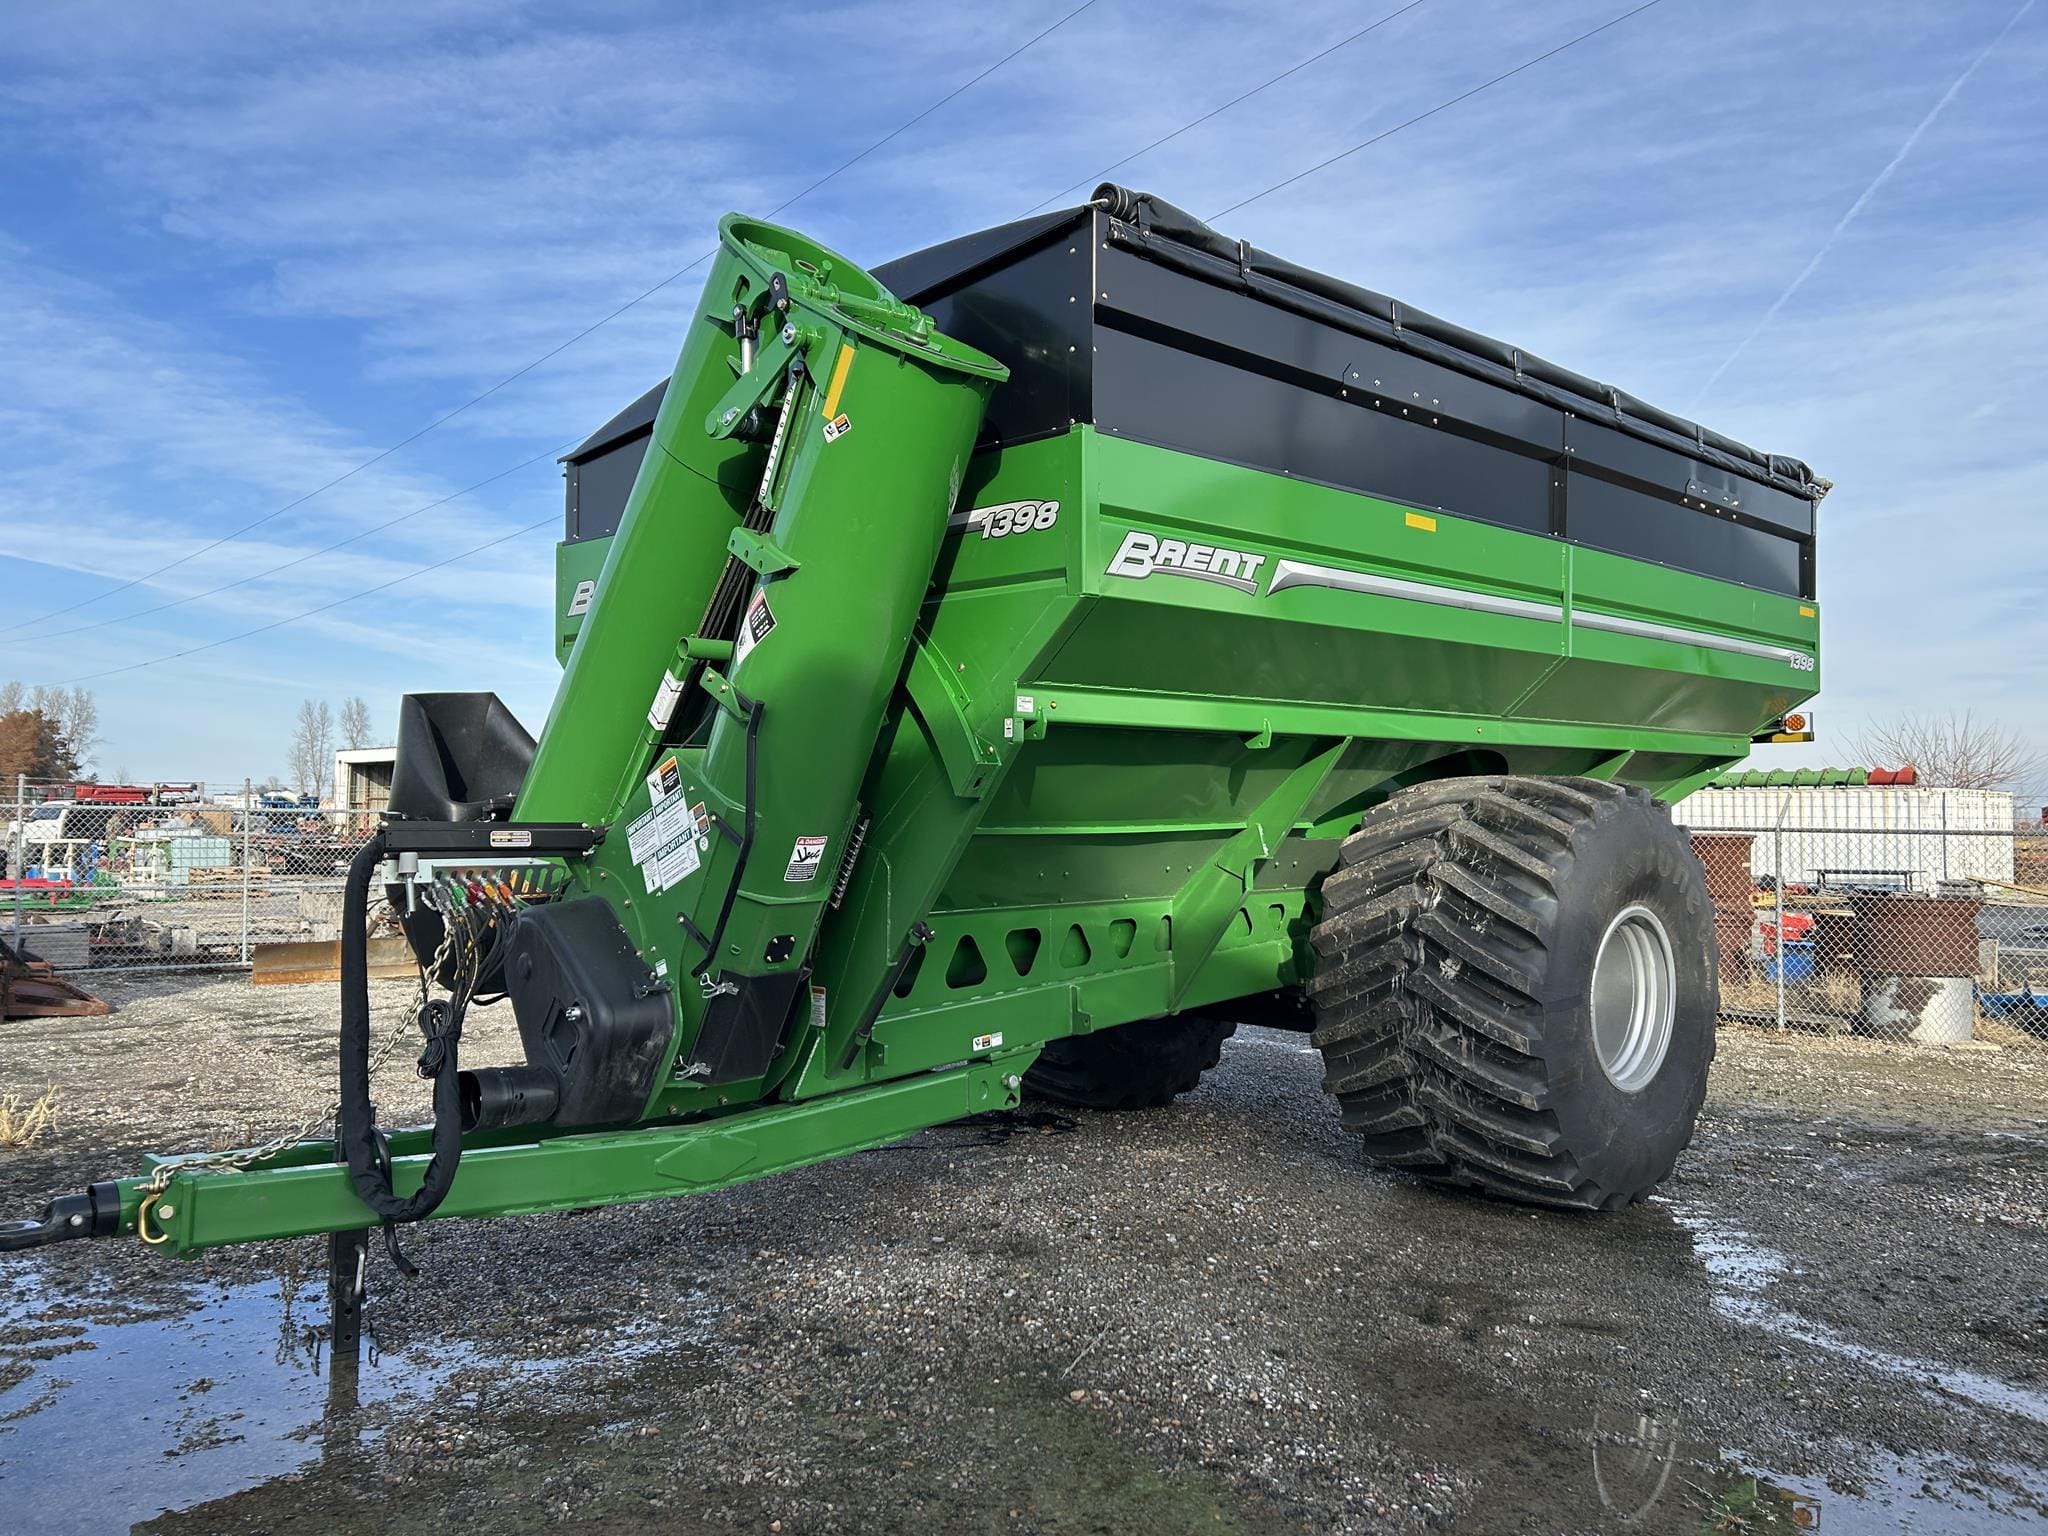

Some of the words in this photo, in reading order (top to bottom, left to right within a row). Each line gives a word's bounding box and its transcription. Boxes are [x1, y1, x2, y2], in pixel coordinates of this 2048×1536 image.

[980, 500, 1060, 539] 1398
[1104, 530, 1267, 583] BRENT
[1790, 653, 1815, 671] 1398
[657, 829, 690, 859] IMPORTANT
